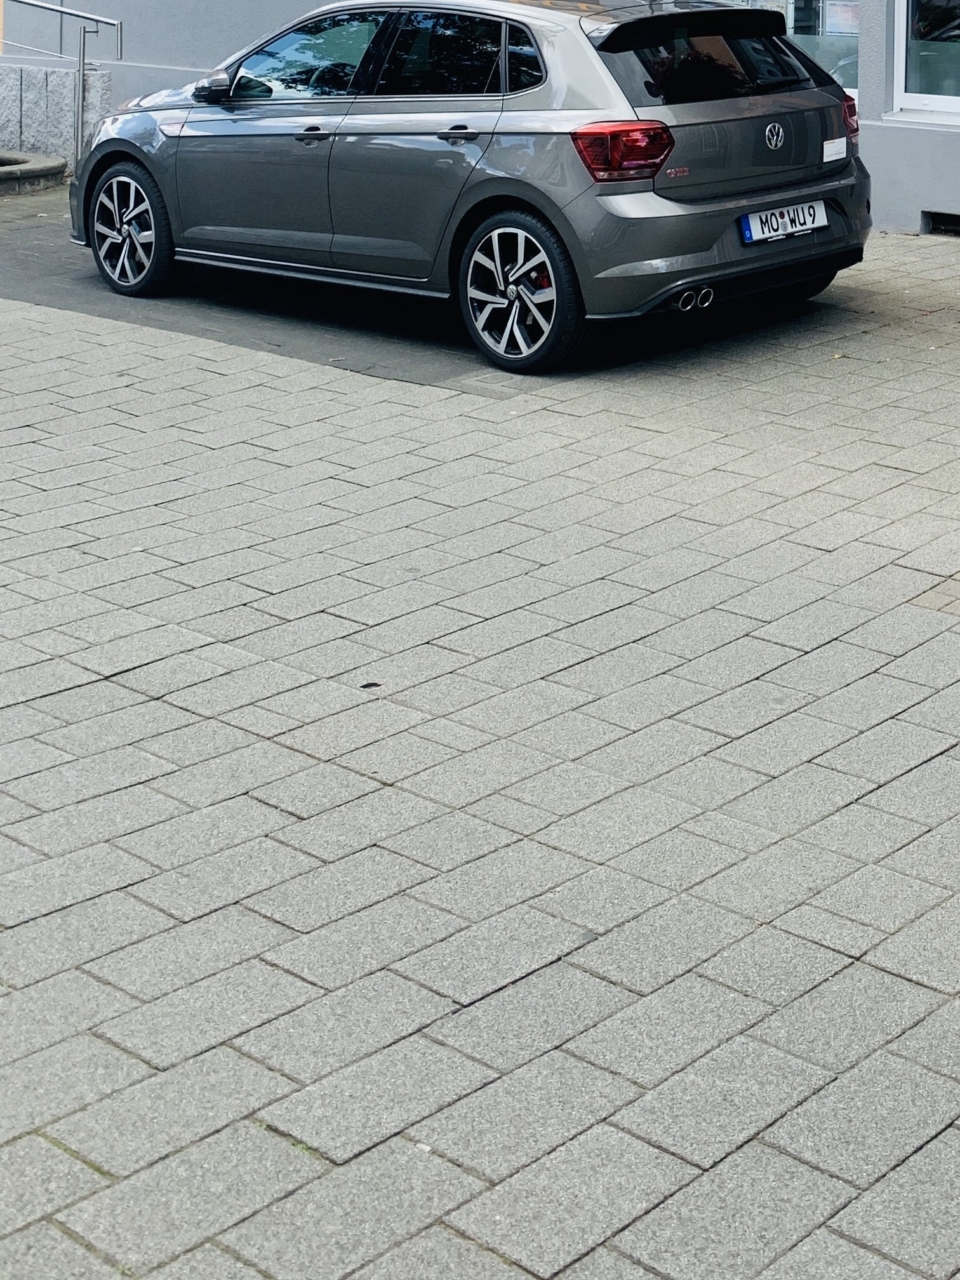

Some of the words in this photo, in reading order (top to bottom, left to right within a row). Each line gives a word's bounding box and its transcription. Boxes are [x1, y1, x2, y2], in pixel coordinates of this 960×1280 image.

[759, 212, 779, 235] MO
[787, 206, 807, 229] WU
[807, 204, 816, 225] 9
